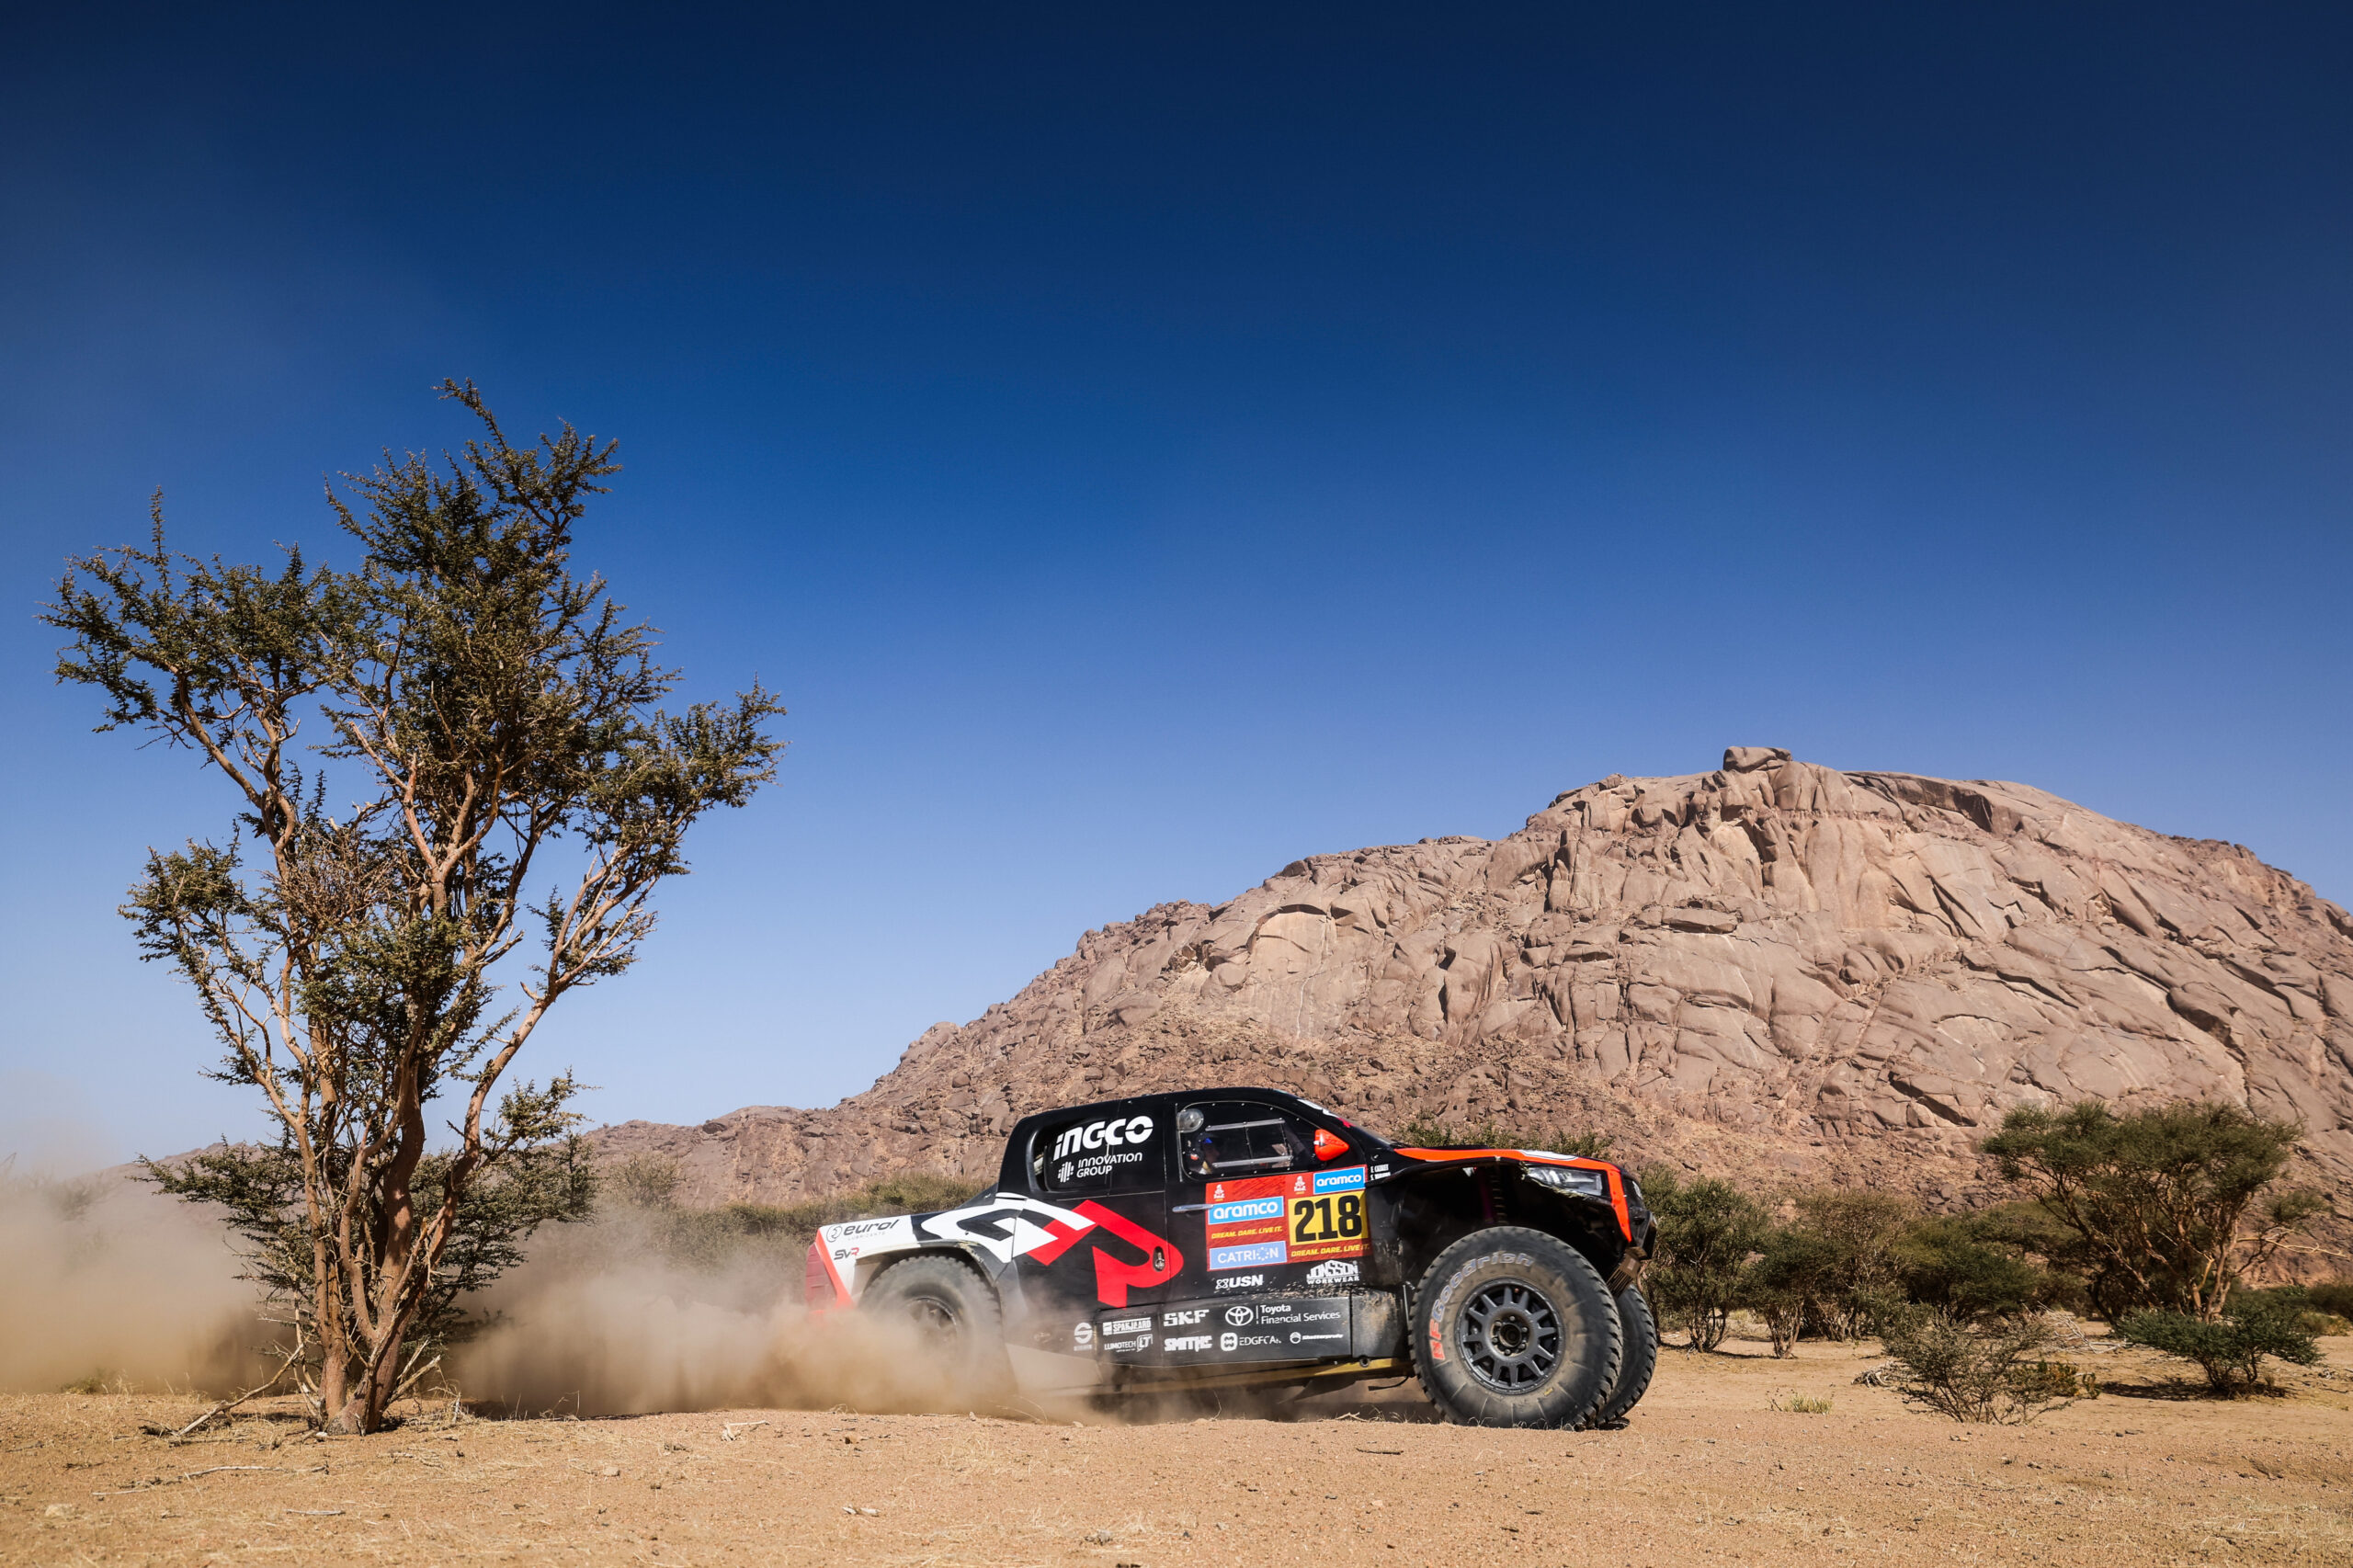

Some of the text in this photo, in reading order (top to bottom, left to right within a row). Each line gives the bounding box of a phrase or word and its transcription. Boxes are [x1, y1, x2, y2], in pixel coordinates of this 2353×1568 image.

[1076, 1165, 1112, 1178] GROUP
[1316, 1174, 1362, 1187] aramco
[1213, 1201, 1279, 1220] aramco
[1294, 1195, 1362, 1243] 218
[844, 1219, 899, 1236] eurol
[1211, 1232, 1236, 1240] DREAM.
[1237, 1229, 1257, 1237] DARE.
[1258, 1226, 1274, 1234] LIVE
[1217, 1246, 1279, 1264] CATRION
[1291, 1249, 1318, 1257] DREAM.
[1320, 1246, 1342, 1255] DARE.
[1306, 1259, 1359, 1278] JONSSON
[1229, 1274, 1264, 1289] USN
[1307, 1276, 1360, 1285] WORKWEAR
[1260, 1304, 1291, 1315] Toyota
[1163, 1309, 1210, 1327] SKF
[1261, 1311, 1341, 1324] Financial Services
